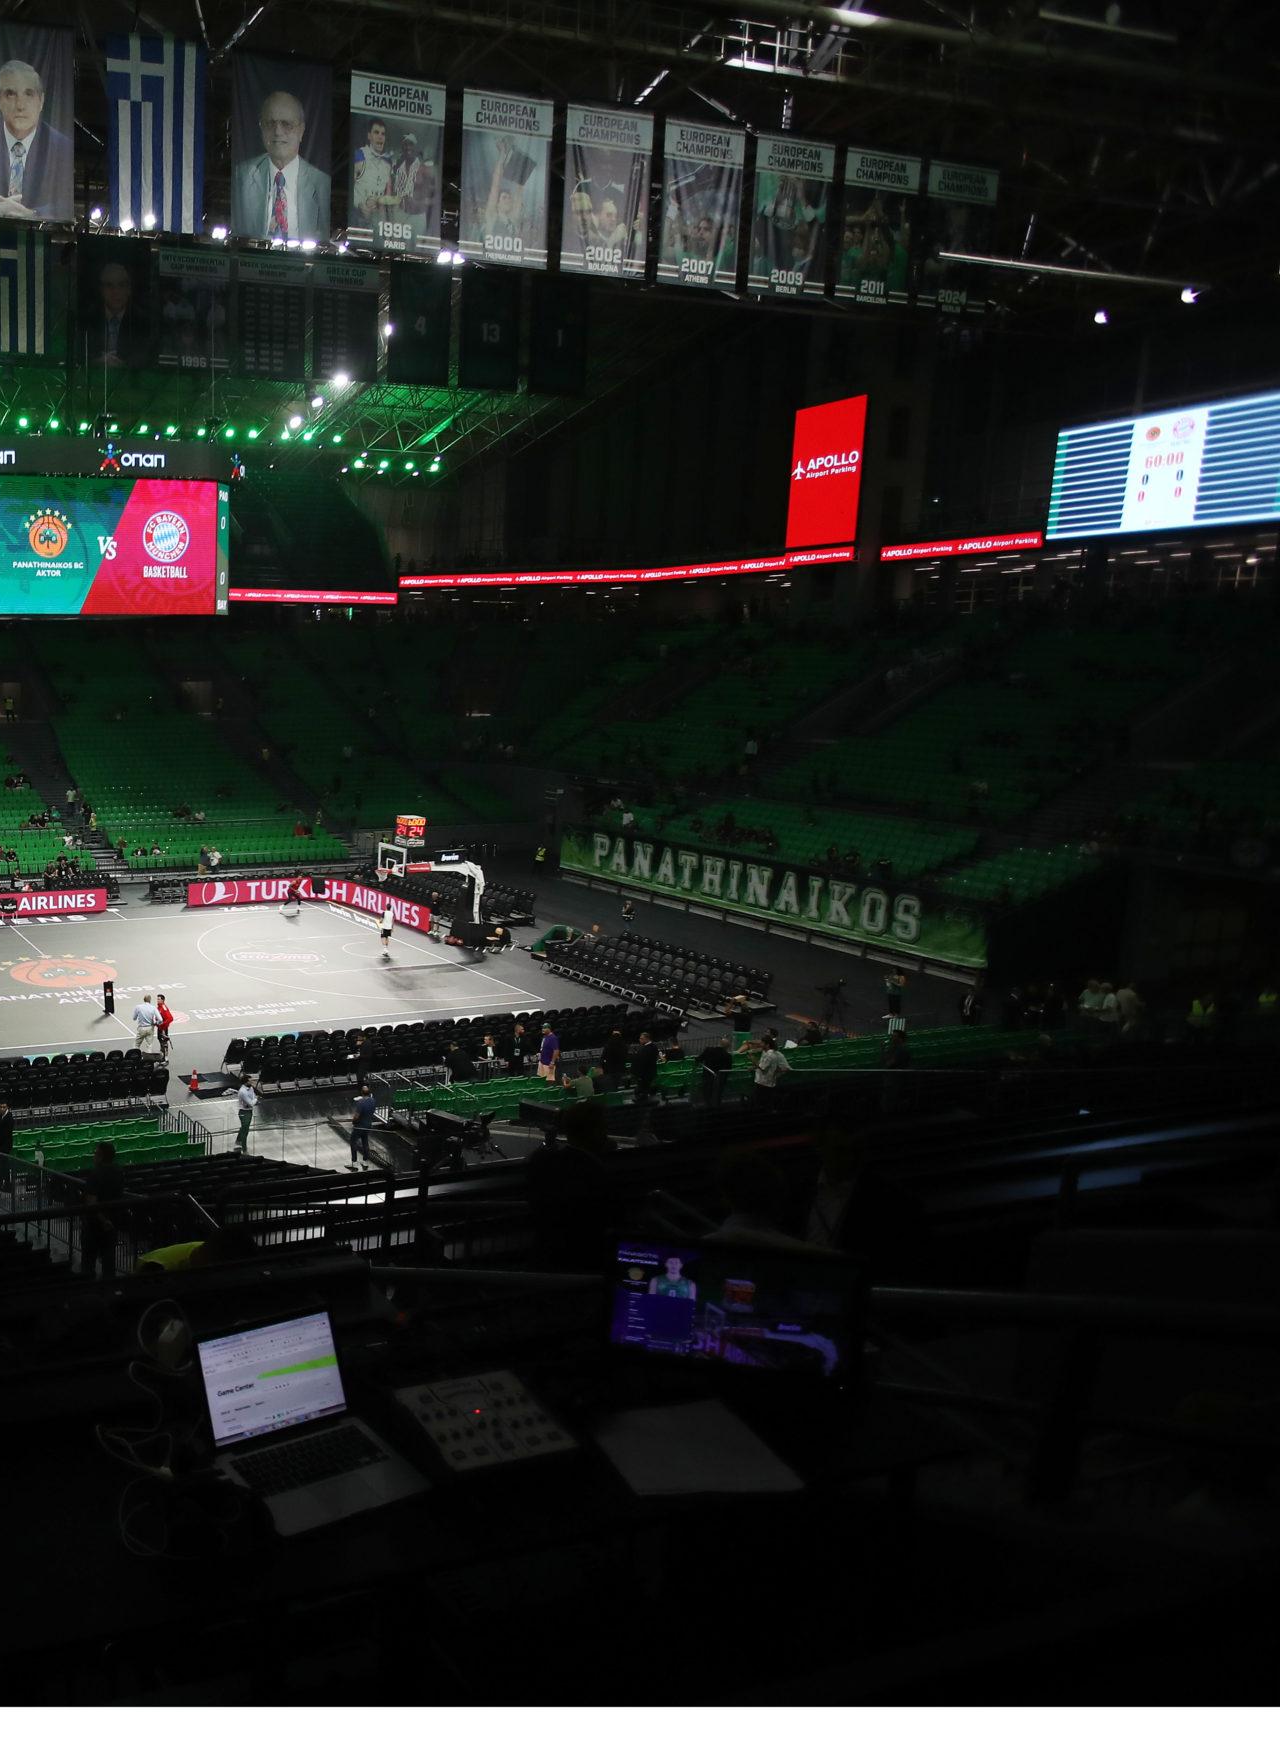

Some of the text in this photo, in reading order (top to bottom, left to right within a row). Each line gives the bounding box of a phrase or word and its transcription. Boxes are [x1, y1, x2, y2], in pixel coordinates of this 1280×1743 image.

[369, 82, 429, 103] EUROPEAN
[364, 94, 432, 116] CHAMPIONS
[481, 99, 537, 119] EUROPEAN
[476, 111, 540, 132] CHAMPIONS
[583, 113, 638, 132] EUROPEAN
[578, 126, 641, 146] CHAMPIONS
[680, 128, 730, 148] EUROPEAN
[676, 141, 733, 160] CHAMPIONS
[772, 143, 821, 162] EUROPEAN
[768, 155, 824, 174] CHAMPIONS
[860, 156, 907, 174] EUROPEAN
[856, 168, 910, 187] CHAMPIONS
[377, 221, 412, 240] 1996
[384, 240, 406, 251] PARIS
[485, 234, 523, 252] 2000
[585, 246, 622, 263] 2002
[681, 257, 714, 275] 2007
[770, 269, 803, 286] 2009
[860, 280, 885, 296] 2011
[807, 450, 859, 471] APOLLO
[1145, 451, 1184, 469] 60:00
[806, 465, 857, 479] Airport Parking
[155, 513, 186, 535] BAYERN
[97, 536, 118, 560] VS
[885, 548, 913, 558] APOLLO
[962, 540, 992, 551] APOLLO
[12, 561, 73, 570] PANATHINAIKOS
[36, 569, 62, 577] AKTOR
[143, 566, 188, 579] BASKETBALL
[409, 826, 424, 837] 24
[593, 832, 921, 944] PANATHINAIKOS
[18, 893, 96, 911] AIRLINES
